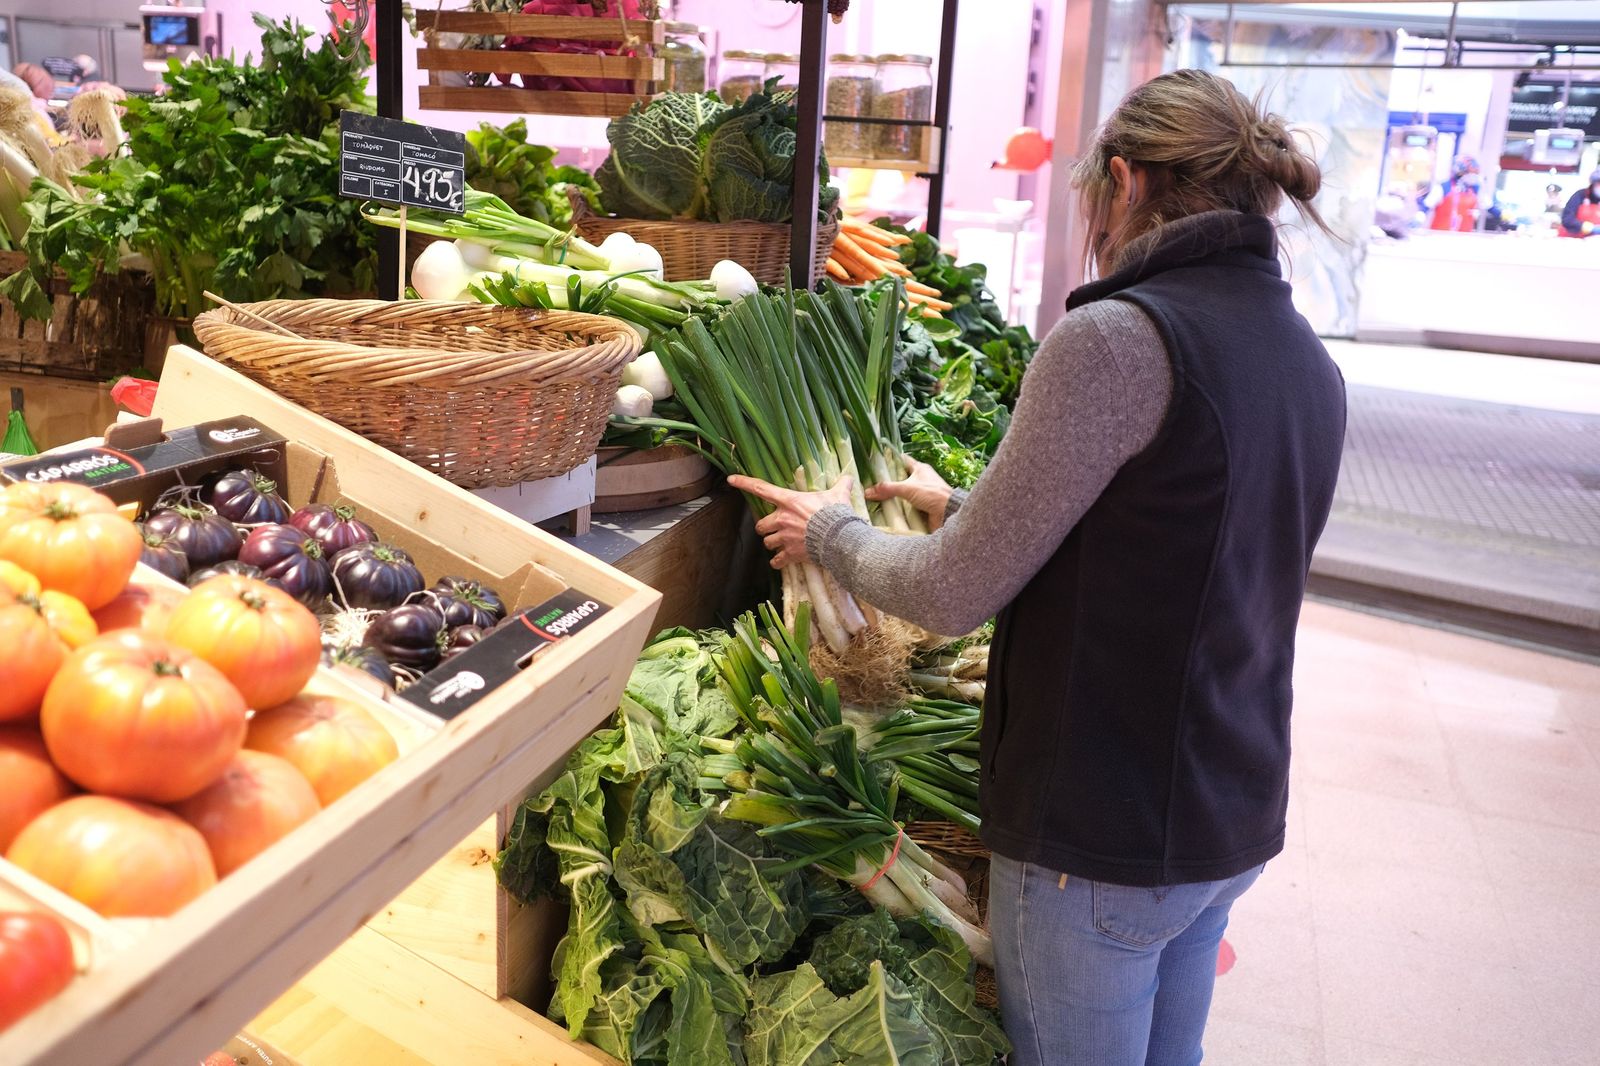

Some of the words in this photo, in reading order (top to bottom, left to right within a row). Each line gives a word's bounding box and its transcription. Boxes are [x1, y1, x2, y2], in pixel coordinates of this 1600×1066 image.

[25, 454, 120, 482] CAPARRÓS
[84, 462, 132, 478] NATURE
[545, 600, 600, 635] CAPARRÓS
